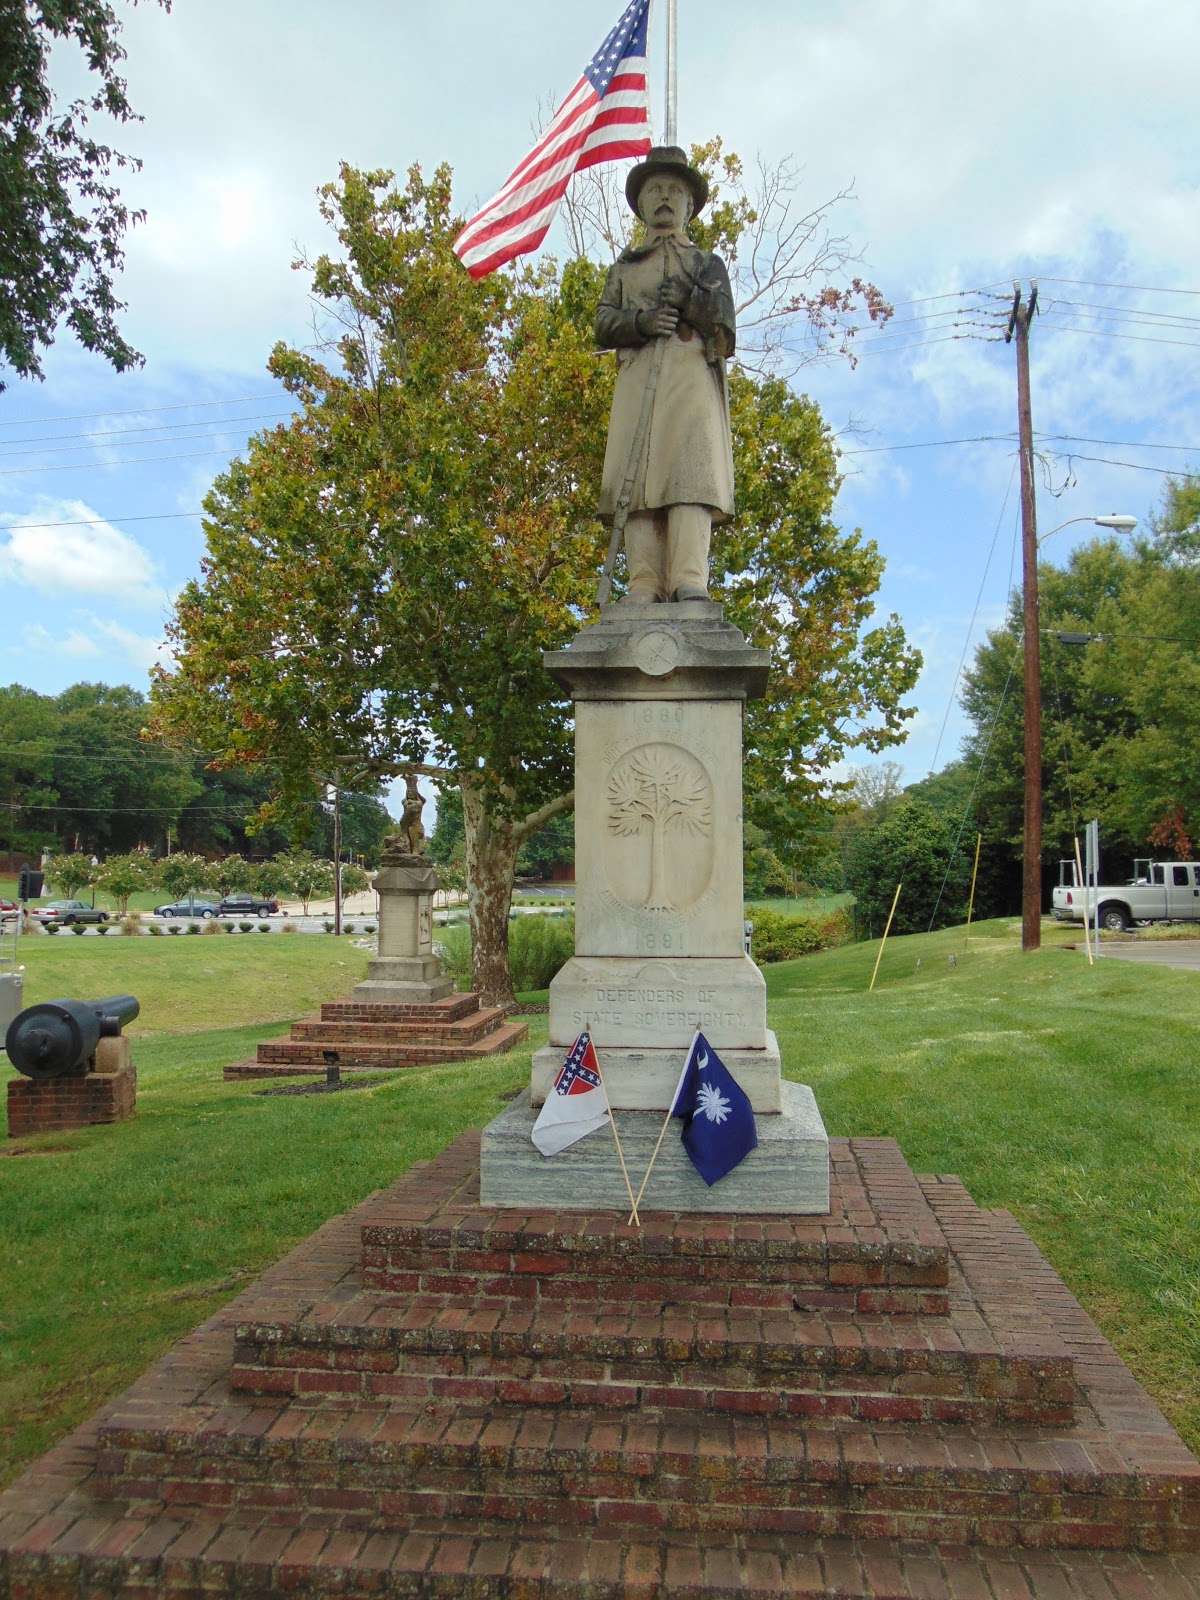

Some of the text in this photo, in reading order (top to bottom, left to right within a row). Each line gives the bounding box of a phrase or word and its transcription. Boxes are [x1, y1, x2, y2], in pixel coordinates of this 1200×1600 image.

[635, 933, 684, 950] 1891
[596, 989, 717, 1003] DEFENDERS OF
[573, 1011, 622, 1026] STATE
